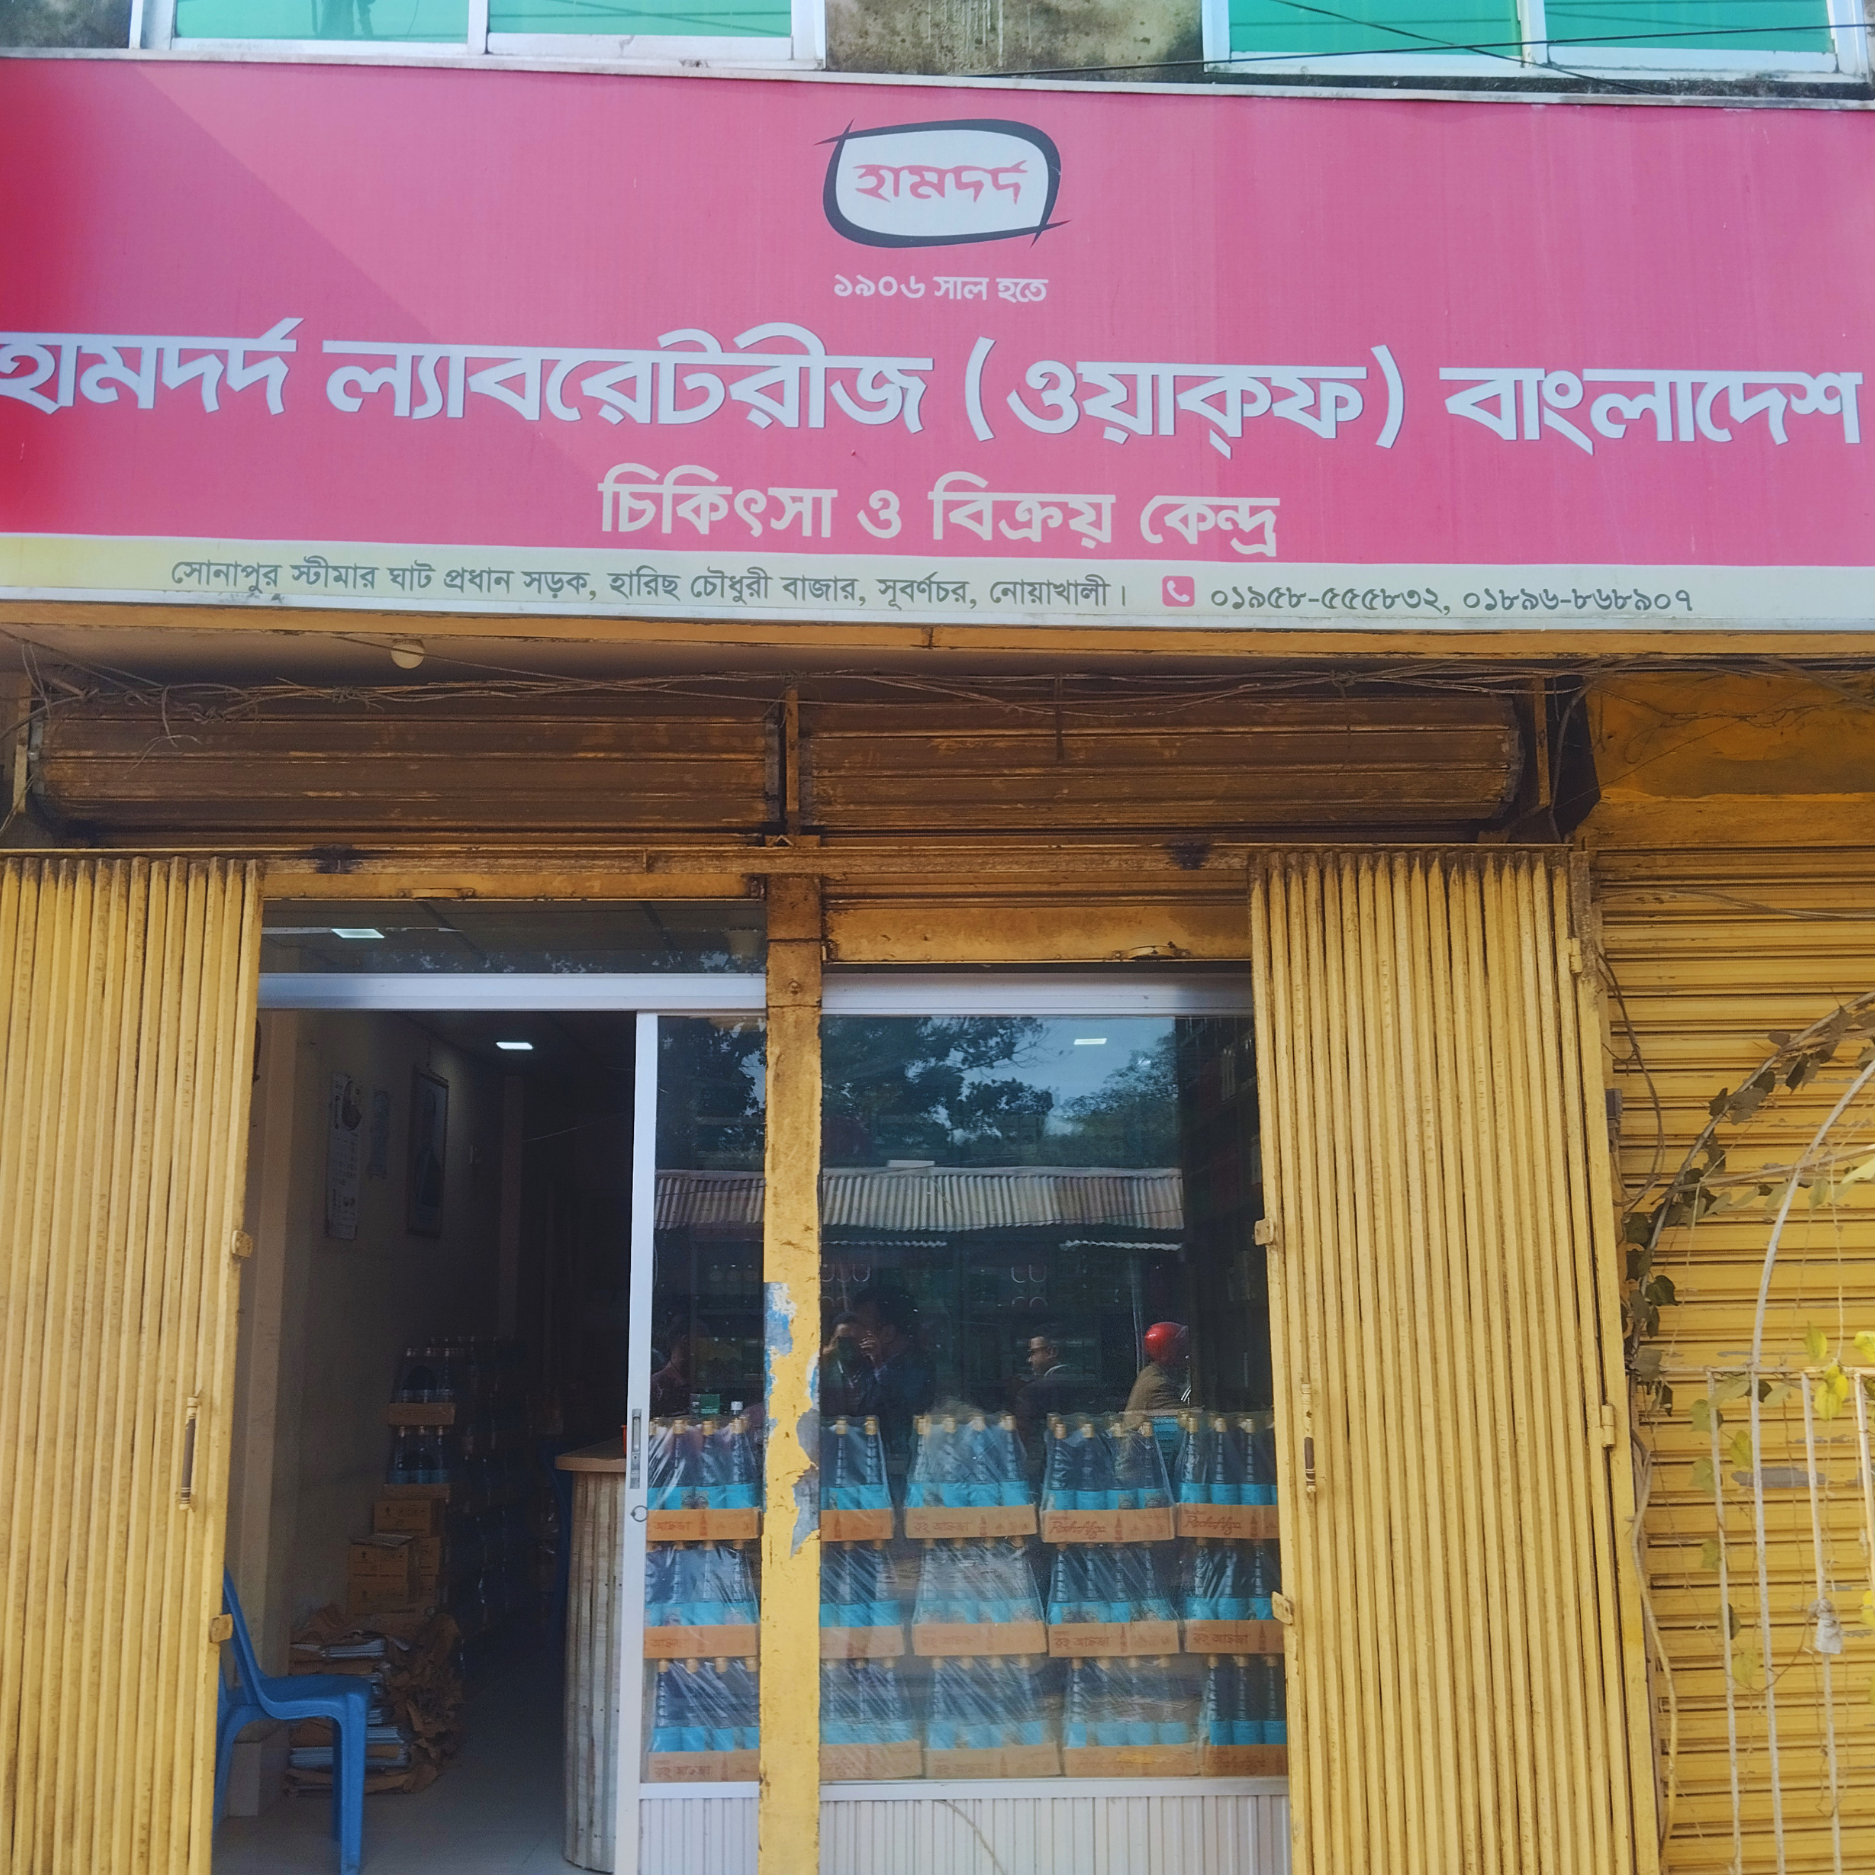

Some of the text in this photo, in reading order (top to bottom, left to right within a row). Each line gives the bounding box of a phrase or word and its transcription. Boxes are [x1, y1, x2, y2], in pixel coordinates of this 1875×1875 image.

[852, 159, 1029, 206] হামদর্দ
[833, 273, 1049, 303] ১৯০৬ সাল হতে
[0, 317, 305, 416] হামদর্দ
[322, 321, 935, 434] ল্যাবরেটরীজ
[1438, 366, 1863, 456] বাংলাদেশ
[597, 462, 1281, 557] চিকিৎসা ও বিক্রয় কেন্দ্র
[171, 558, 284, 594] সোনাপুর
[289, 554, 380, 590] স্টীমার
[386, 559, 436, 592] ঘাট
[443, 566, 516, 594] প্রধান
[520, 570, 597, 601] সড়ক,
[606, 564, 683, 602] হারিছ
[690, 565, 774, 606] চৌধুরী
[779, 573, 867, 607] বাজার,
[1210, 585, 1451, 616] ০১৯৫৮-৫৫৫৮৩২,
[1462, 587, 1694, 612] ০১৮৯৬-৮৬৮৯০৭
